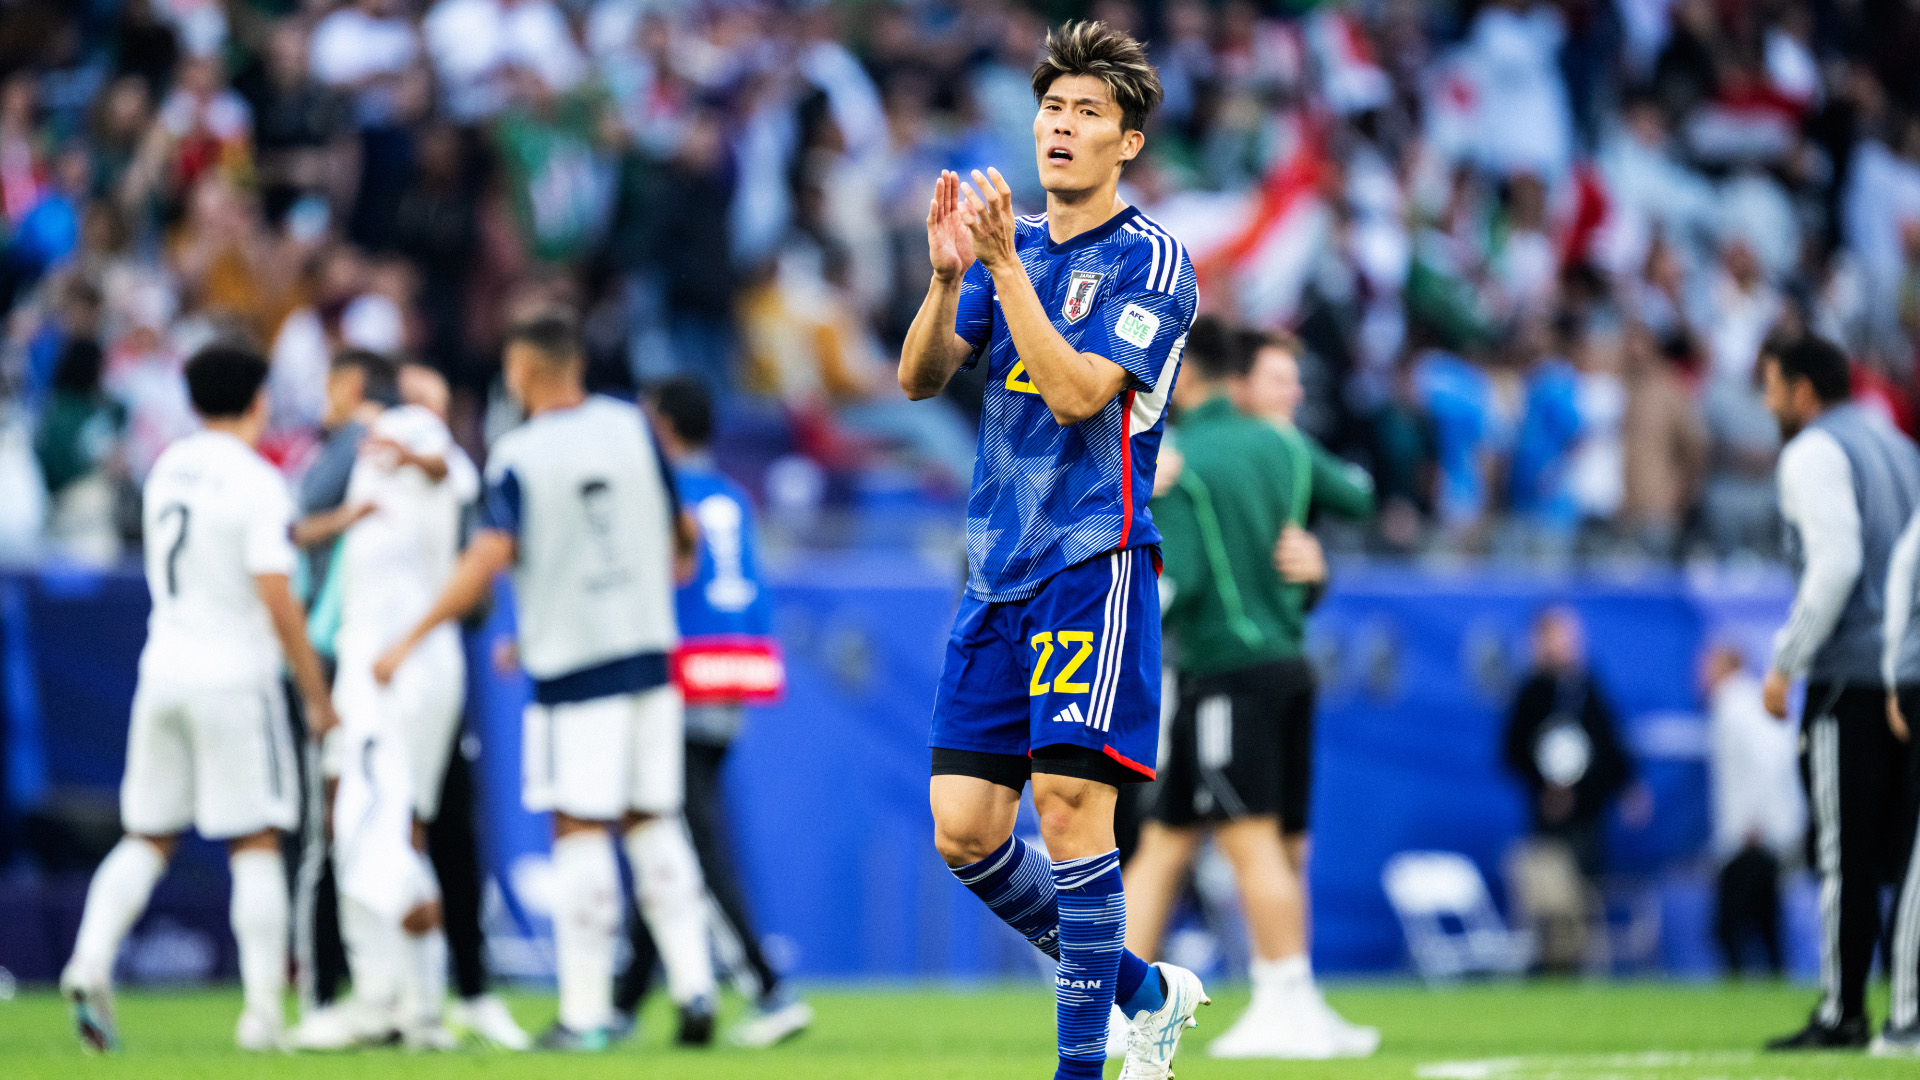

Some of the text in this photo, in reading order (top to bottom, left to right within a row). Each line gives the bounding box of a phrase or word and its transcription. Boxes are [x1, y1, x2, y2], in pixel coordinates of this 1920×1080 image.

[1124, 315, 1151, 335] LIVE
[1129, 310, 1145, 322] AFC
[1029, 630, 1094, 697] 22
